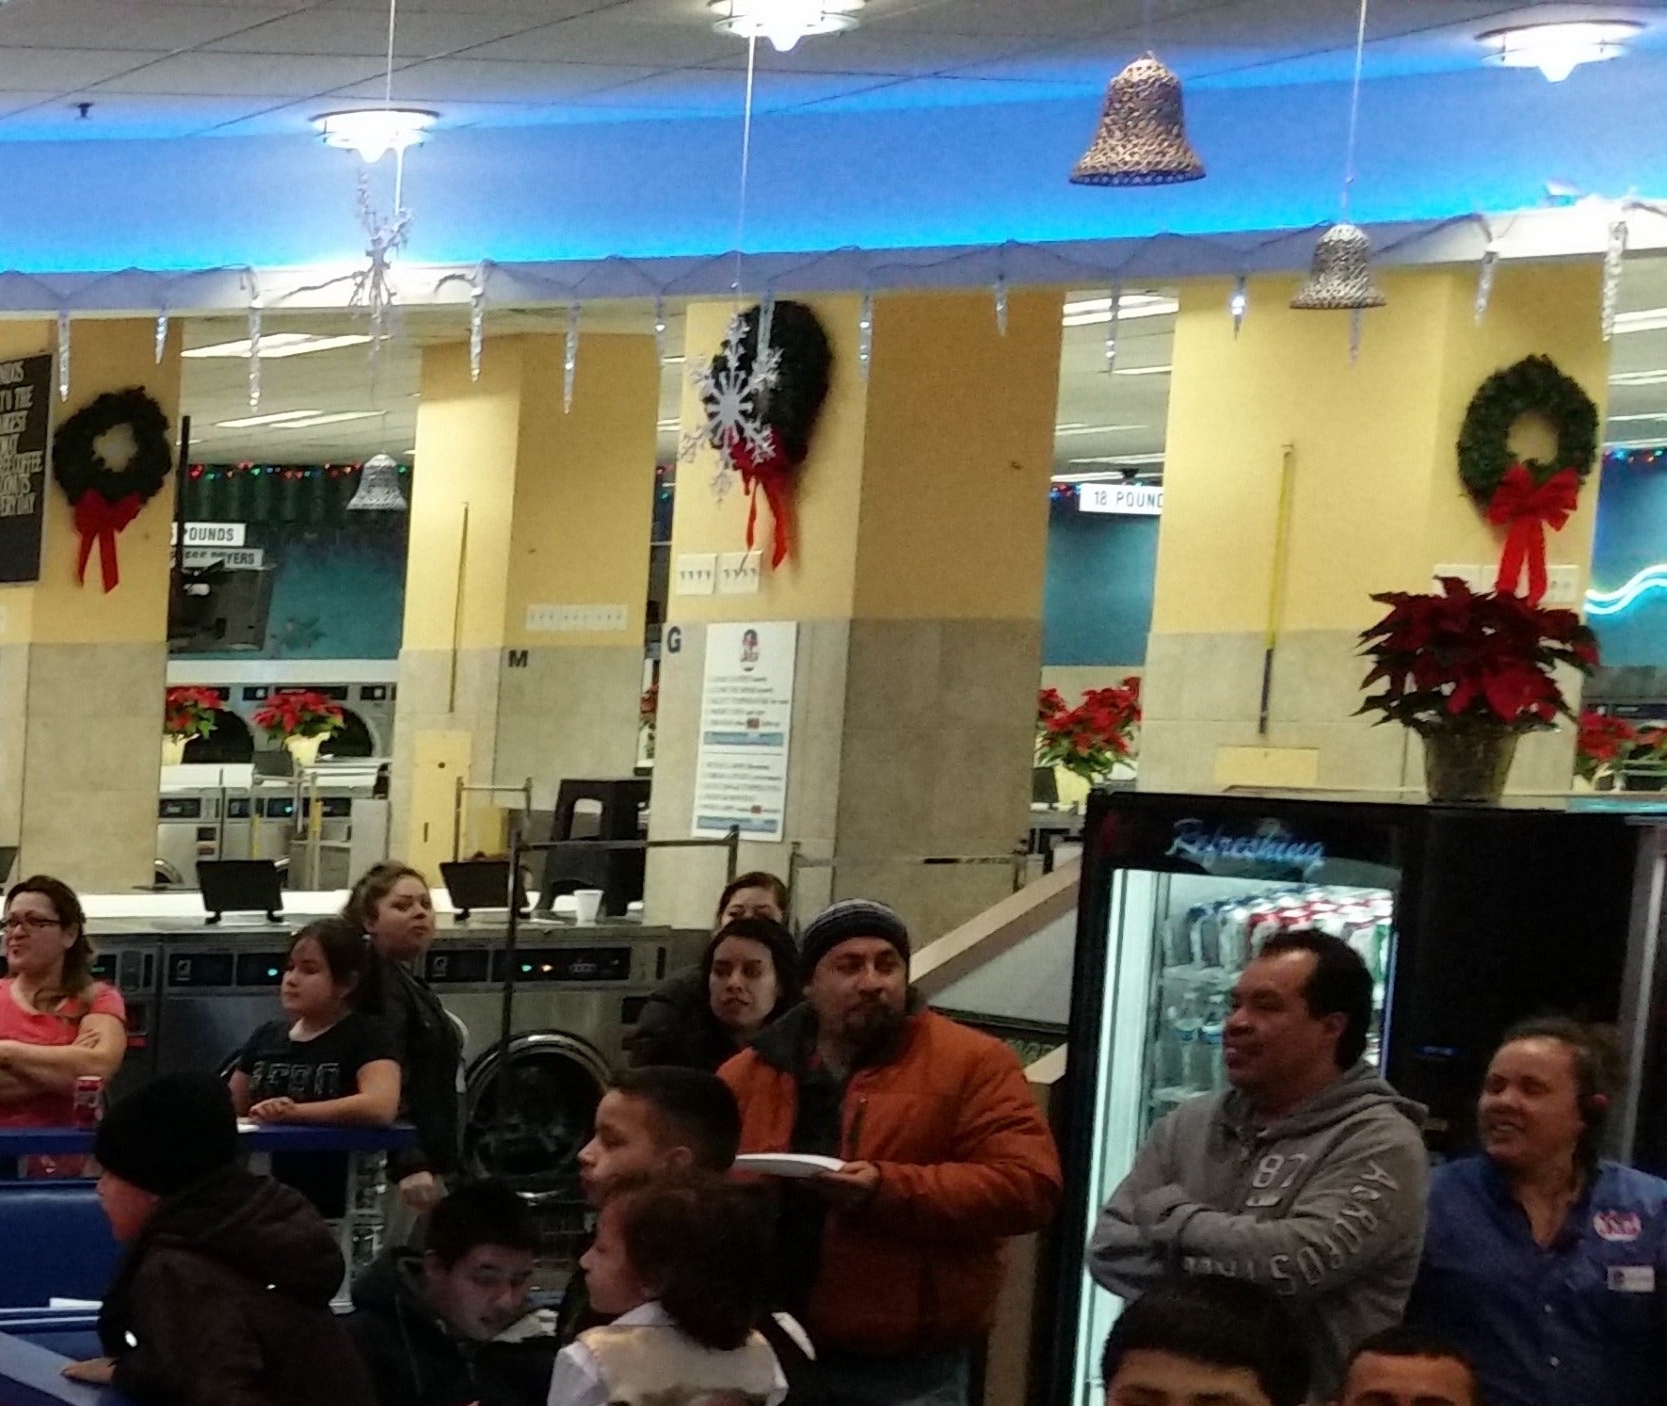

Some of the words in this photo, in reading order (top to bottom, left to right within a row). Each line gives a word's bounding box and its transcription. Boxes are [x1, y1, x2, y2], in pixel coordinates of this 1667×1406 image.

[1094, 489, 1107, 506] 18
[1116, 490, 1164, 508] POUND
[185, 526, 235, 542] OUNDS
[667, 625, 682, 653] G
[507, 649, 529, 668] M
[1252, 1153, 1309, 1189] 87
